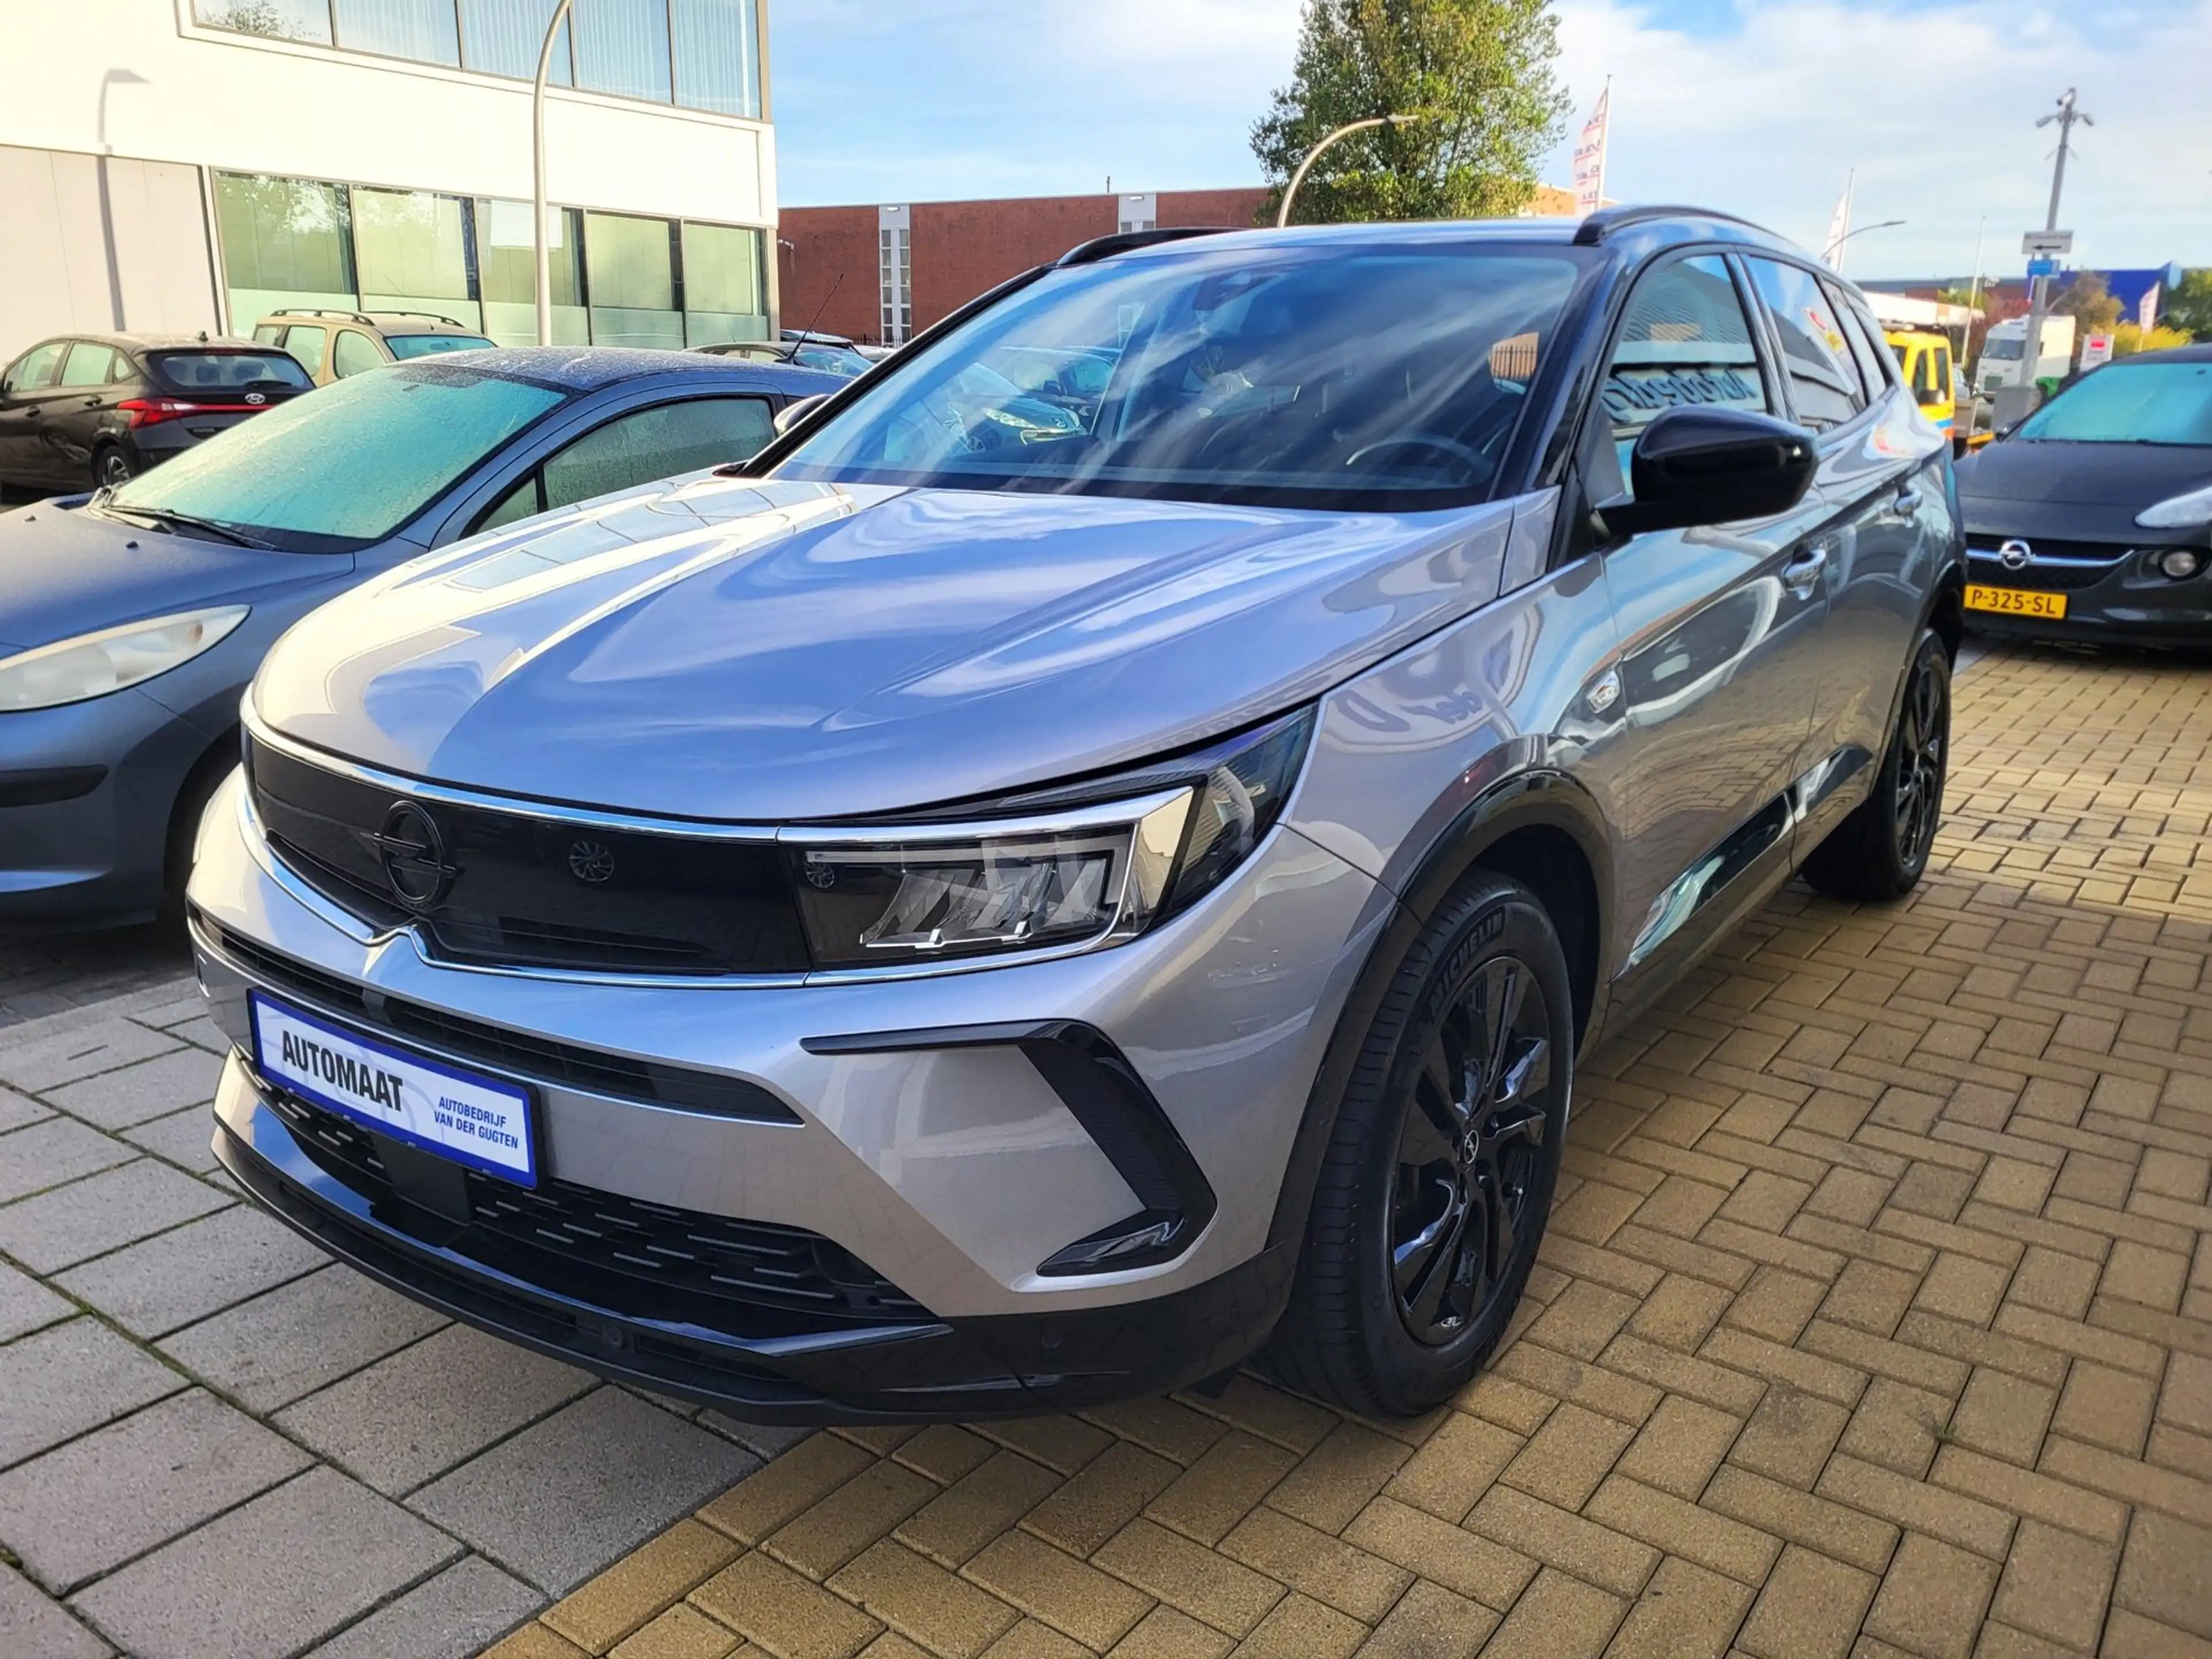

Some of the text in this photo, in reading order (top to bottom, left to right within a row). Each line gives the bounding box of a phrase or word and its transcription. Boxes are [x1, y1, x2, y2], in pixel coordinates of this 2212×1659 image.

[1972, 589, 2056, 615] P-325-SL
[1429, 912, 1503, 1020] MICHELIN
[282, 1029, 403, 1112] AUTOMAAT
[434, 1110, 519, 1149] VAN DER GUGTEN
[438, 1096, 507, 1129] AUTOBEDRIJF
